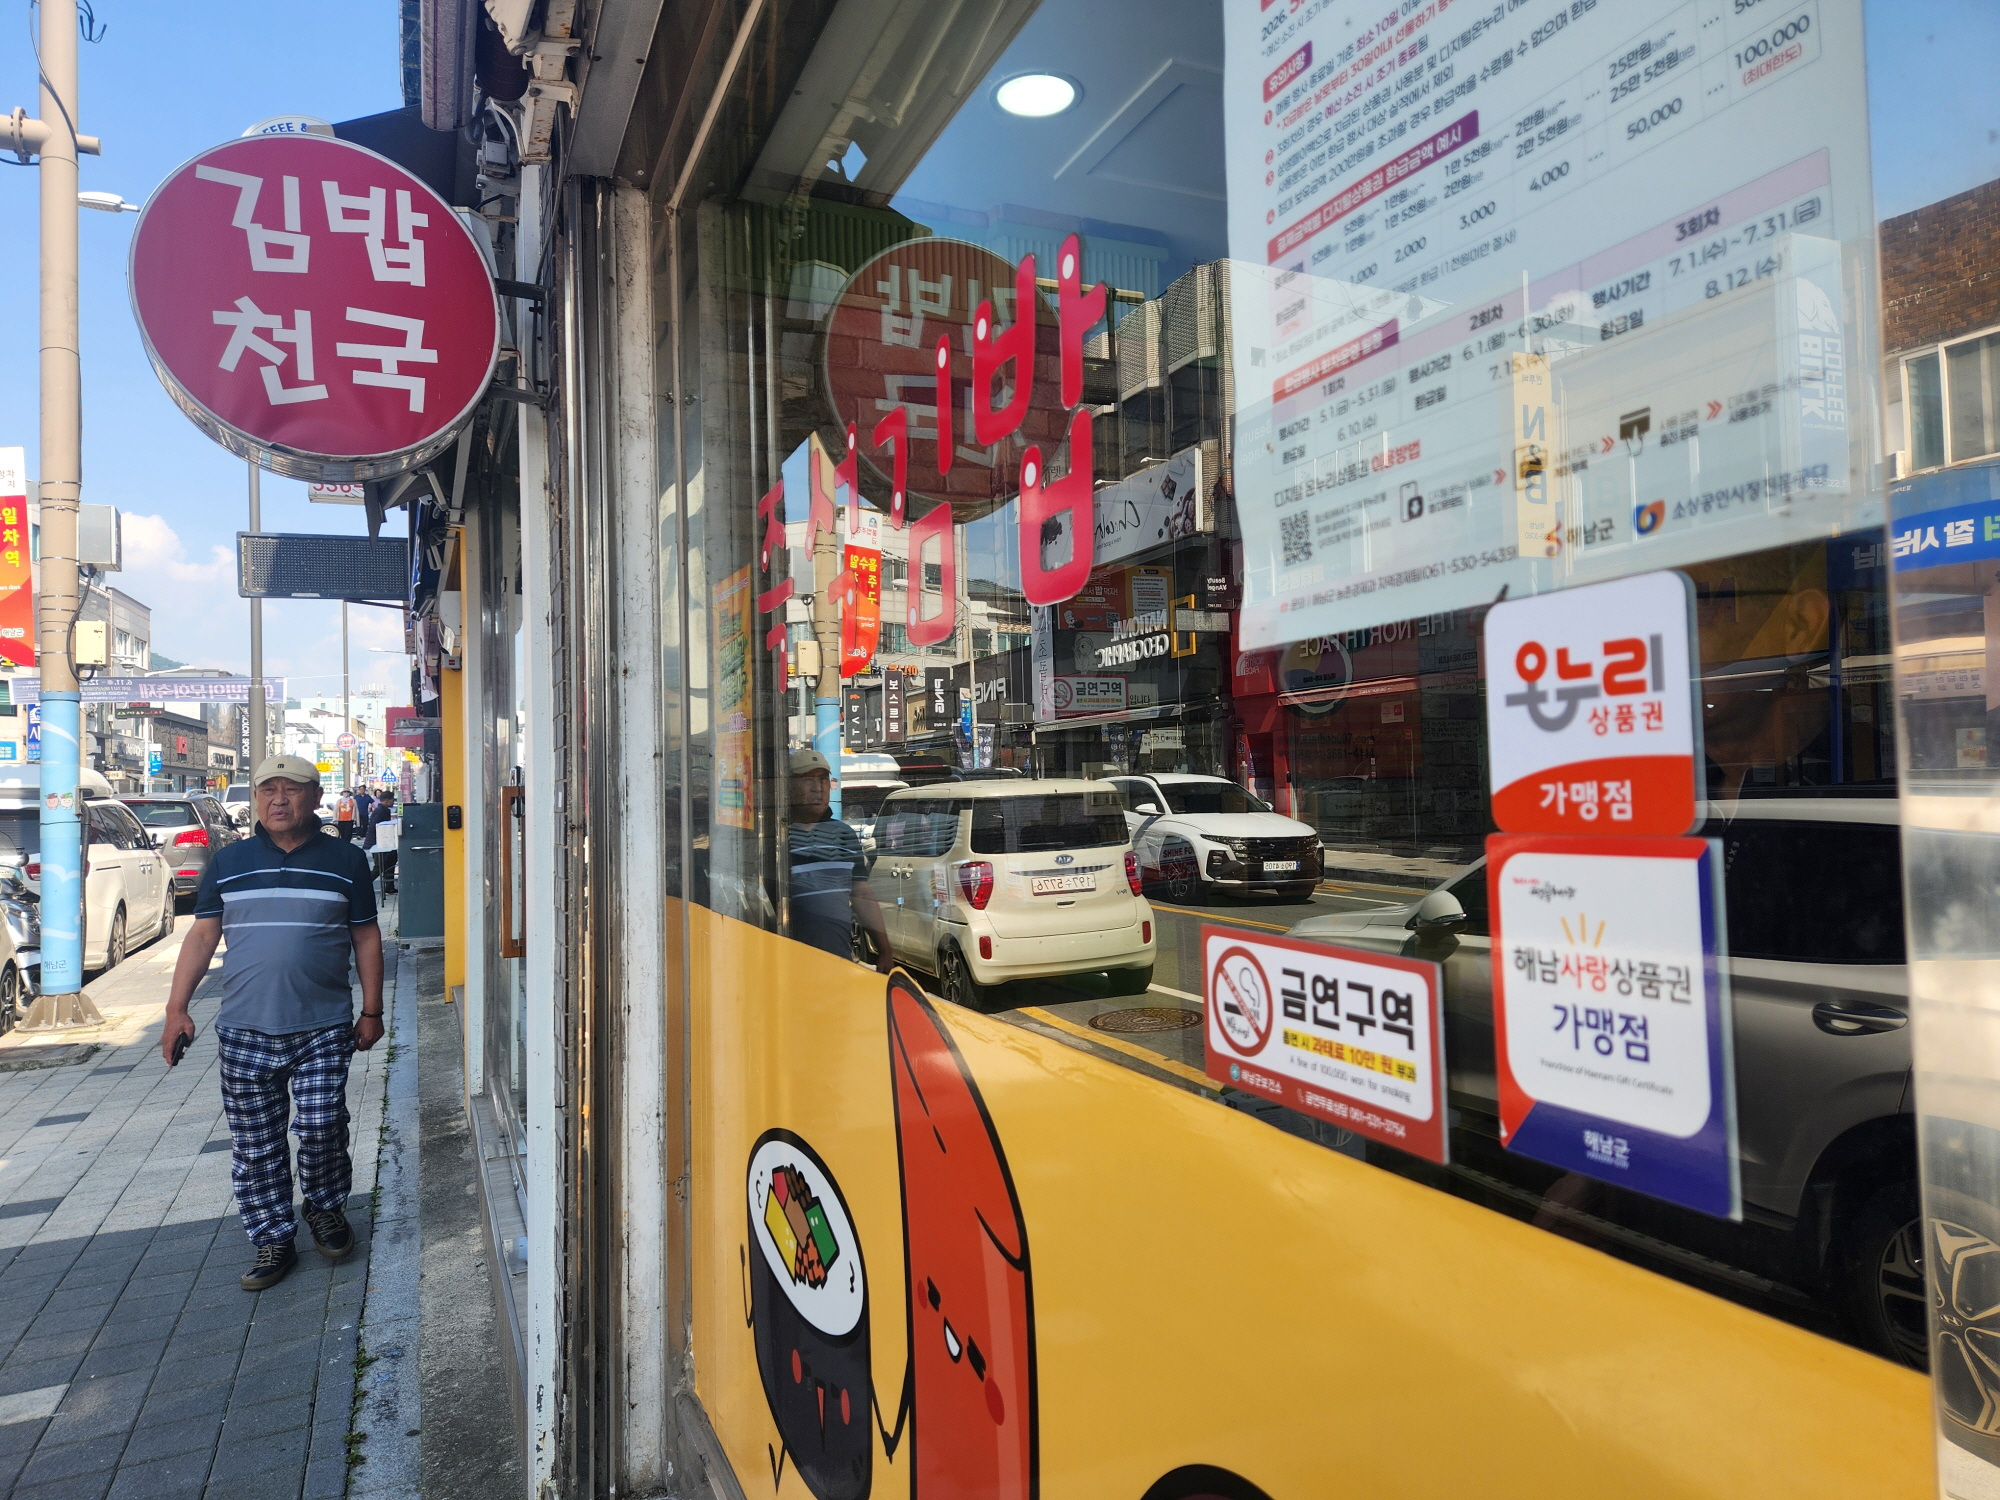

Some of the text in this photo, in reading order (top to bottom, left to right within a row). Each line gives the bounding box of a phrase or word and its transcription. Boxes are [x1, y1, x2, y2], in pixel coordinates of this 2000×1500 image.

[1262, 9, 1288, 42] 2026.
[1269, 50, 1306, 94] 유의사항
[1309, 58, 1335, 89] 종료일
[1336, 43, 1355, 68] 기준
[1314, 69, 1349, 106] 날로부터
[1395, 4, 1436, 46] 선물하기
[1398, 34, 1430, 68] 종료됨
[1742, 42, 1804, 88] (최대한도)
[1363, 85, 1391, 117] 상품권
[1394, 63, 1425, 96] 사용분
[1426, 53, 1437, 72] 및
[1377, 119, 1408, 150] 초과할
[1409, 105, 1431, 130] 경우
[1479, 48, 1514, 83] 수령할
[1516, 39, 1529, 57] 수
[1530, 9, 1568, 49] 없으며
[1432, 63, 1454, 91] 제외
[1393, 13, 1811, 264] 2,000 3,000 4,000 50,000 100,000
[1436, 125, 1463, 155] 예시
[195, 163, 429, 288] 김밥
[1469, 303, 1504, 332] 2회차
[1675, 206, 1721, 243] 3회차
[1408, 352, 1452, 385] 행사기간
[1592, 271, 1652, 309] 행사기간
[212, 295, 439, 414] 천국
[1414, 386, 1448, 412] 환급일
[1600, 309, 1645, 342] 환급일
[1, 628, 25, 638] 해남군
[1075, 681, 1123, 696] 금연구역
[1588, 700, 1664, 737] 상품권
[1539, 779, 1633, 821] 가맹점
[1512, 945, 1692, 1005] 해남사랑상품권
[1280, 966, 1416, 1052] 금연구역
[1552, 1001, 1651, 1063] 가맹점
[1300, 1034, 1311, 1049] 시
[1312, 1037, 1346, 1061] 과태료
[1350, 1047, 1376, 1069] 10만
[1379, 1055, 1393, 1075] 원
[1396, 1062, 1417, 1082] 부과
[1241, 1068, 1283, 1096] 해남군보건소
[1631, 1077, 1675, 1096] Certificate
[1582, 1128, 1630, 1159] 해남군
